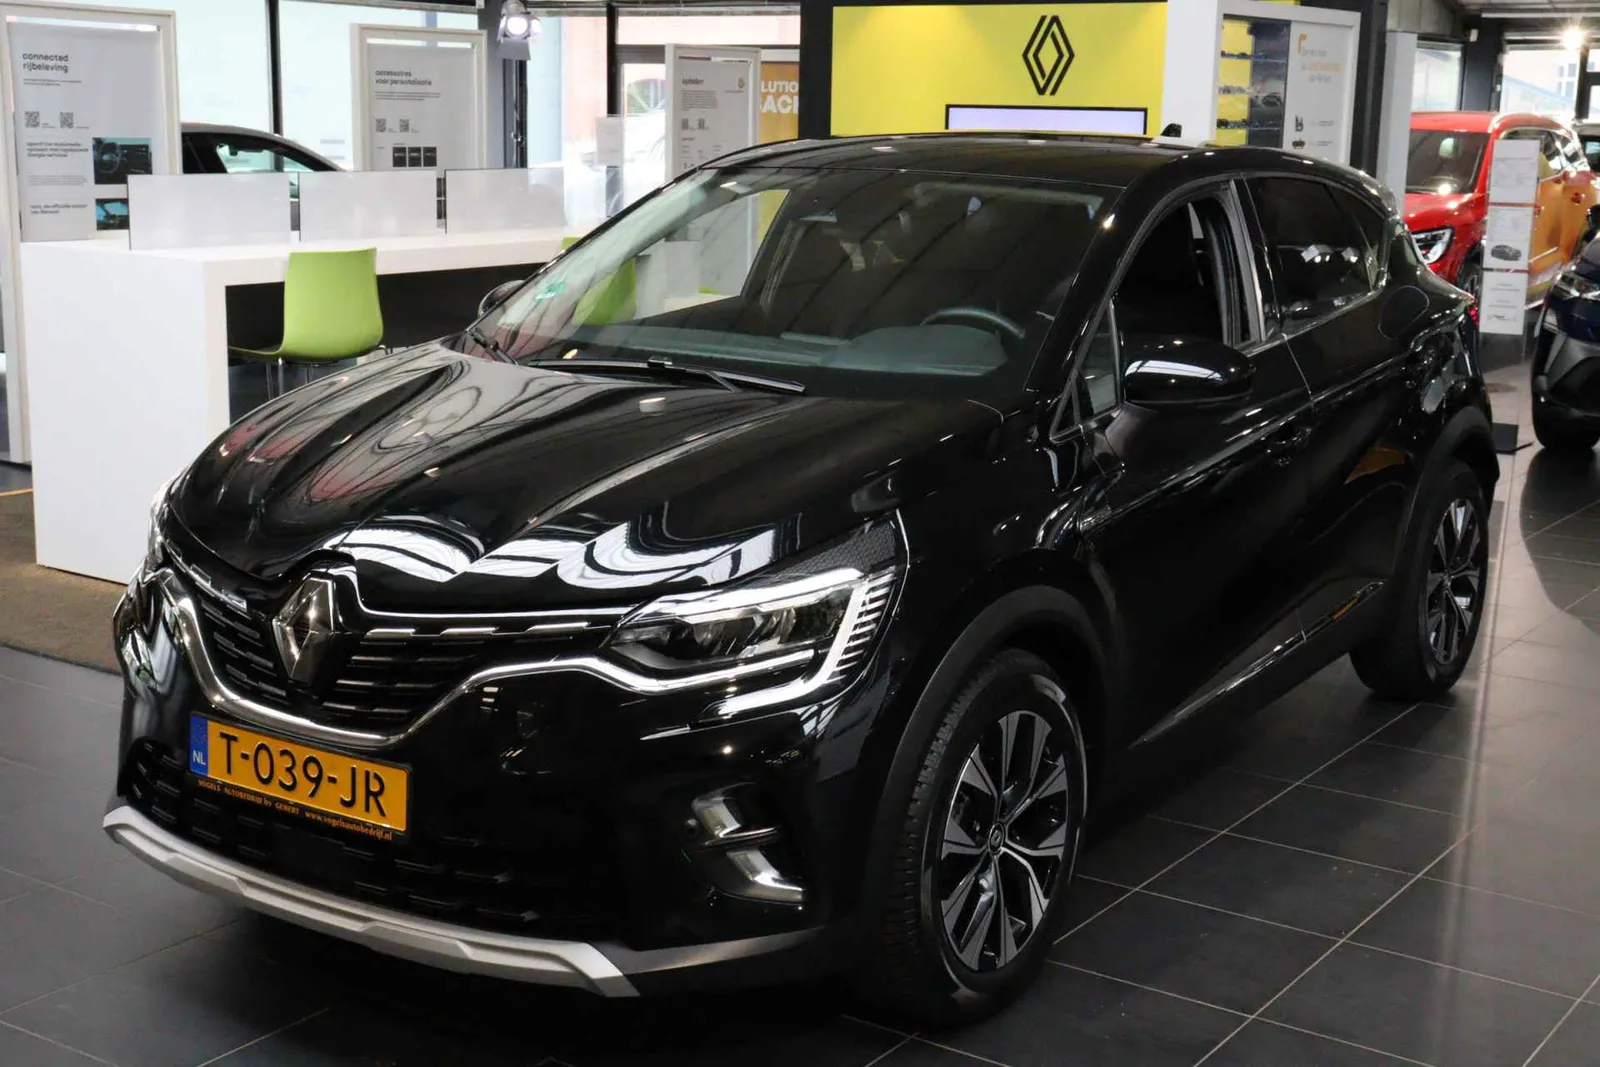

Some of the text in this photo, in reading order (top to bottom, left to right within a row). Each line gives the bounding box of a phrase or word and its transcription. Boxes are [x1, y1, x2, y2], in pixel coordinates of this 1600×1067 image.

[22, 52, 69, 62] connected
[22, 62, 69, 74] rijbeleving
[192, 751, 206, 767] NL
[219, 731, 387, 818] T-039-JR
